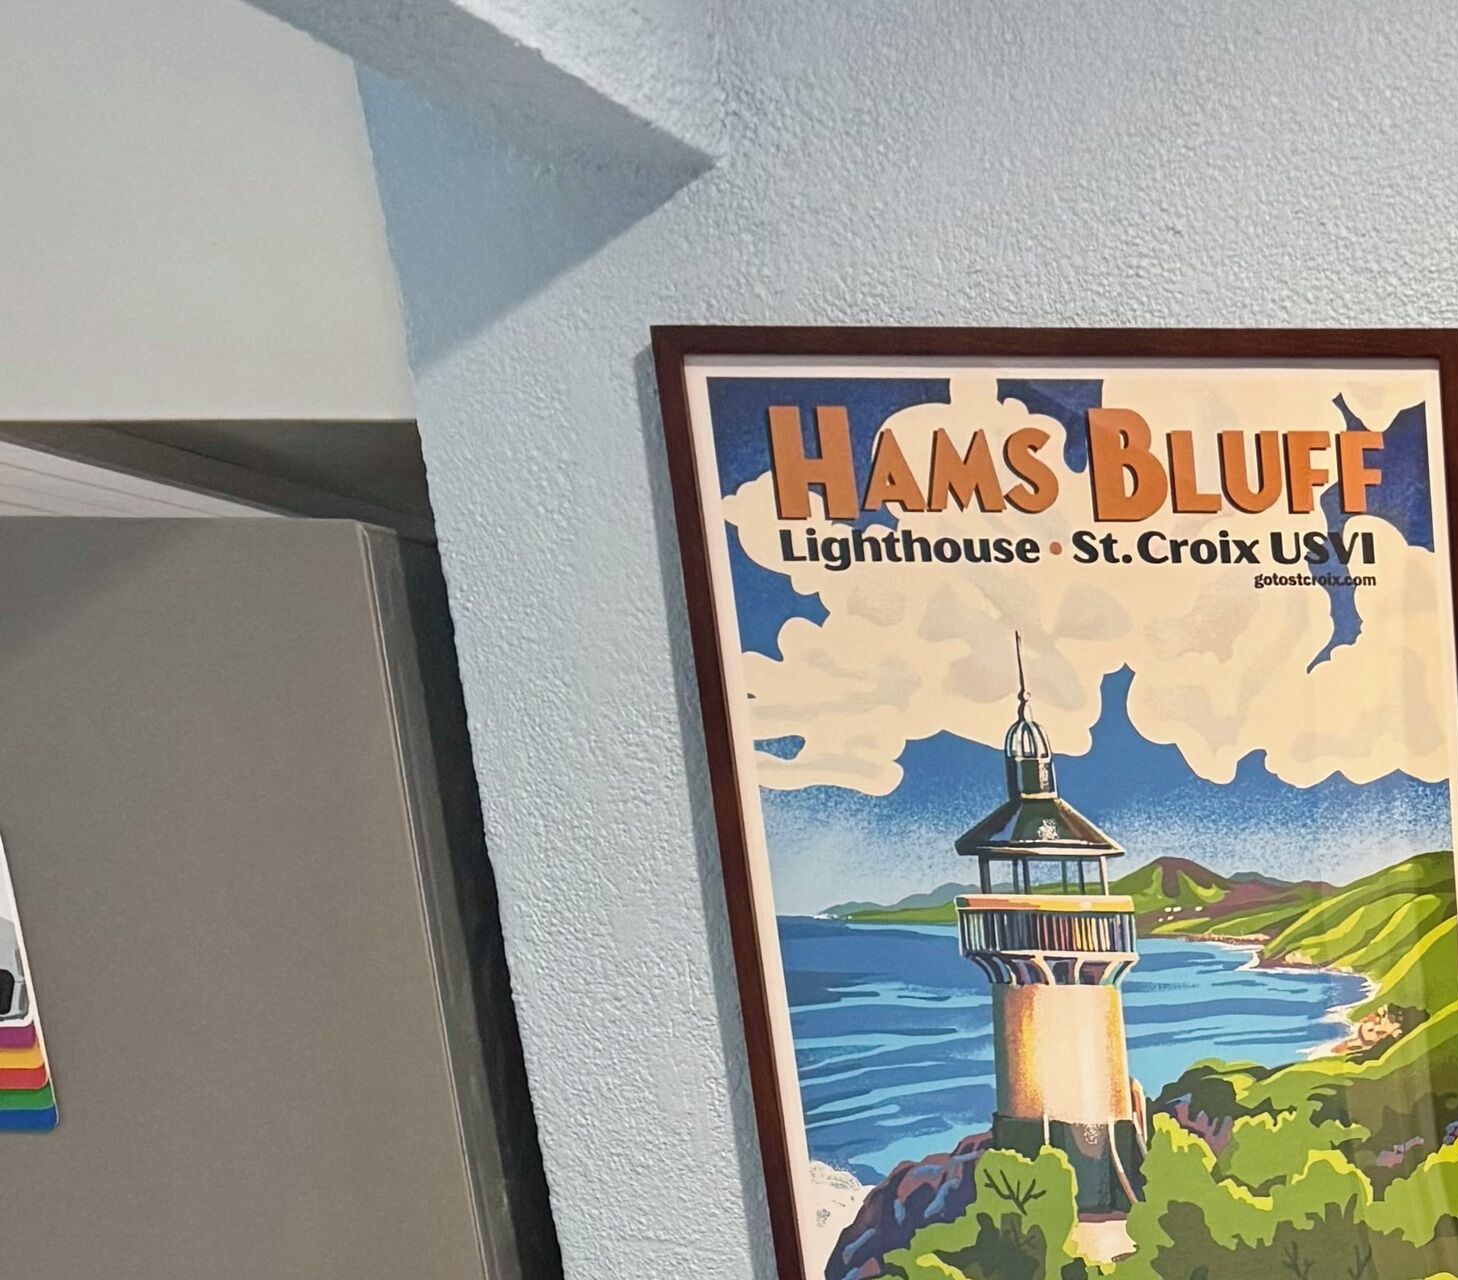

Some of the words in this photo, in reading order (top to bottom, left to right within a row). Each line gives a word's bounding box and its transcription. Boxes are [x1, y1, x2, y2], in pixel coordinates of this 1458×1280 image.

[768, 406, 1060, 520] HAMS
[1087, 408, 1385, 522] BLUFF
[779, 527, 1041, 571] Lighthouse
[1270, 532, 1376, 564] USVI
[1254, 573, 1377, 589] gotostcroix.com
